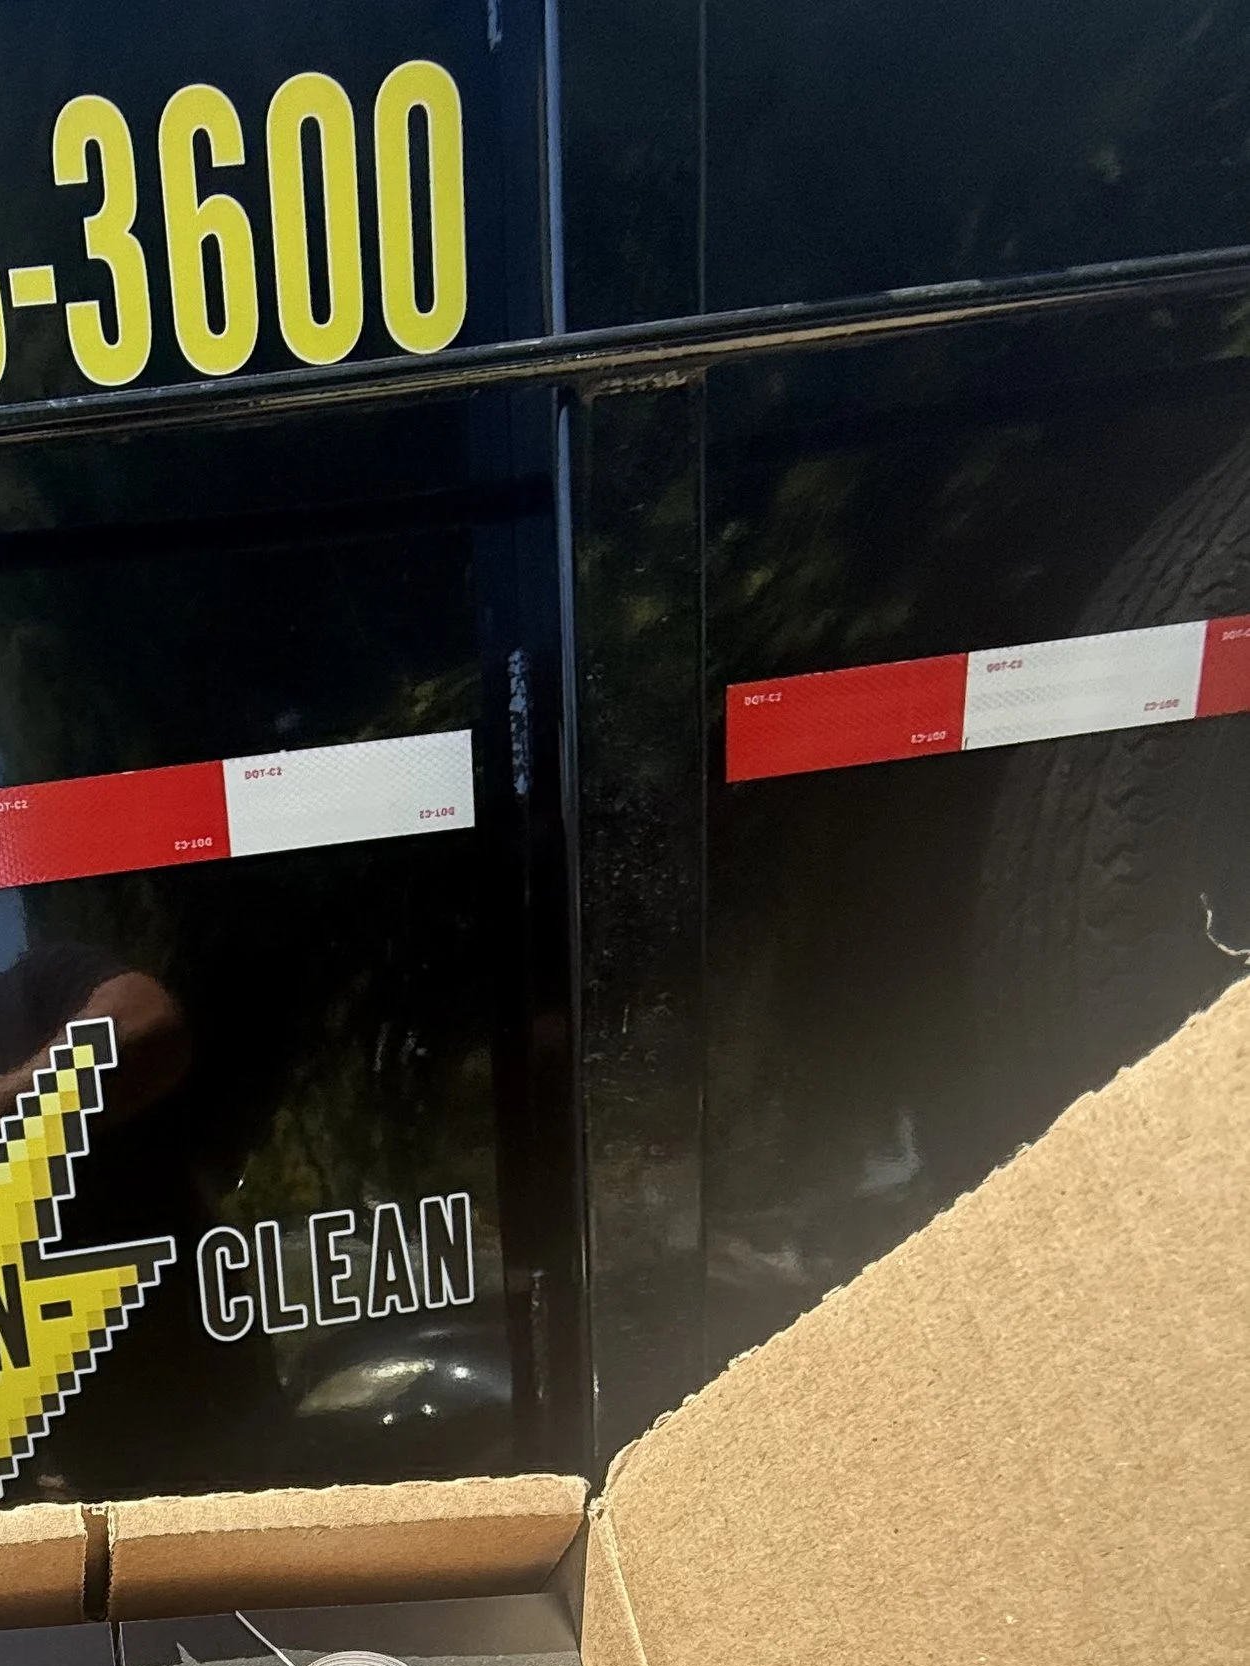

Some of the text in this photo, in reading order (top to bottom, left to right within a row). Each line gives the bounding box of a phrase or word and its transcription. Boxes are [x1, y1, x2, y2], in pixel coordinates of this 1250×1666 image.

[244, 767, 283, 780] DOT-C2
[419, 806, 455, 819] DOT-C2
[174, 837, 212, 850] DOT-C2
[196, 1192, 476, 1342] CLEAN
